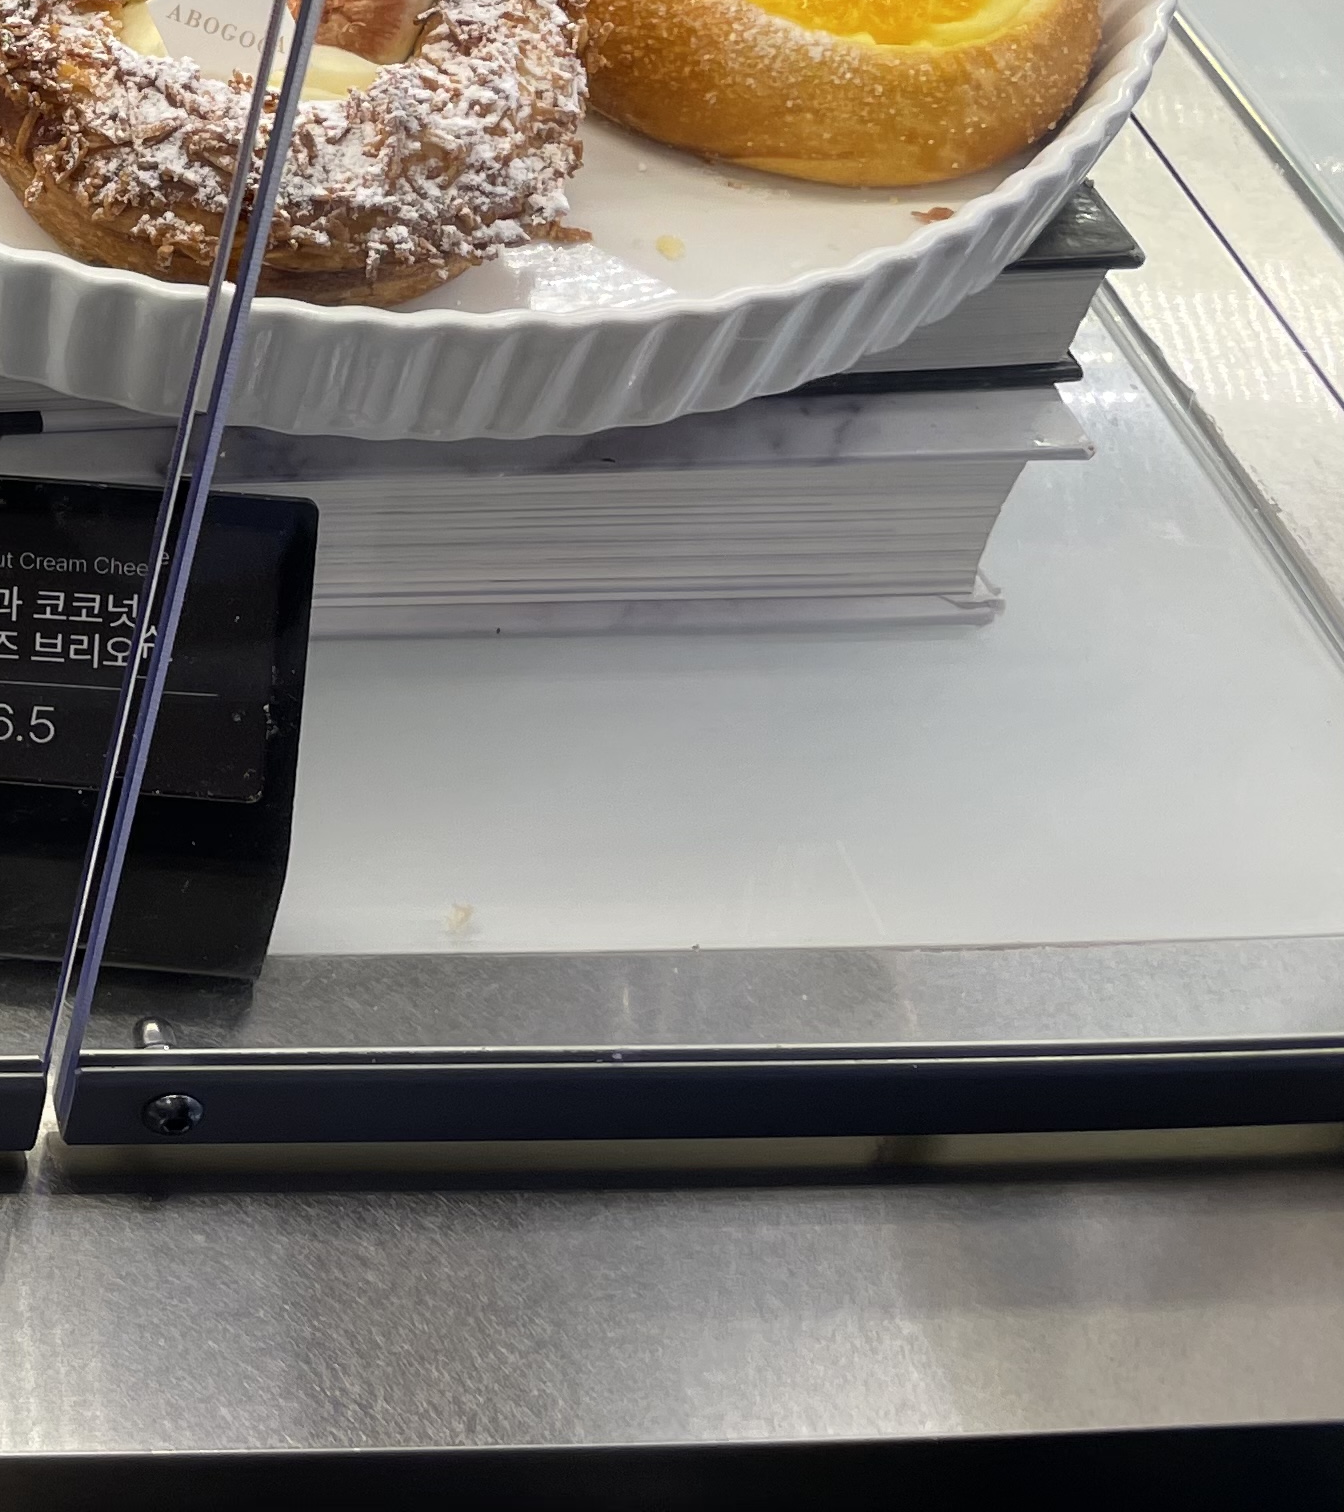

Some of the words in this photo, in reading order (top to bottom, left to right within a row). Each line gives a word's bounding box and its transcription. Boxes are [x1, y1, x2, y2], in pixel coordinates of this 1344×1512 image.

[20, 552, 88, 573] Cream
[93, 550, 170, 578] Cheee
[33, 589, 140, 628] 코코넛
